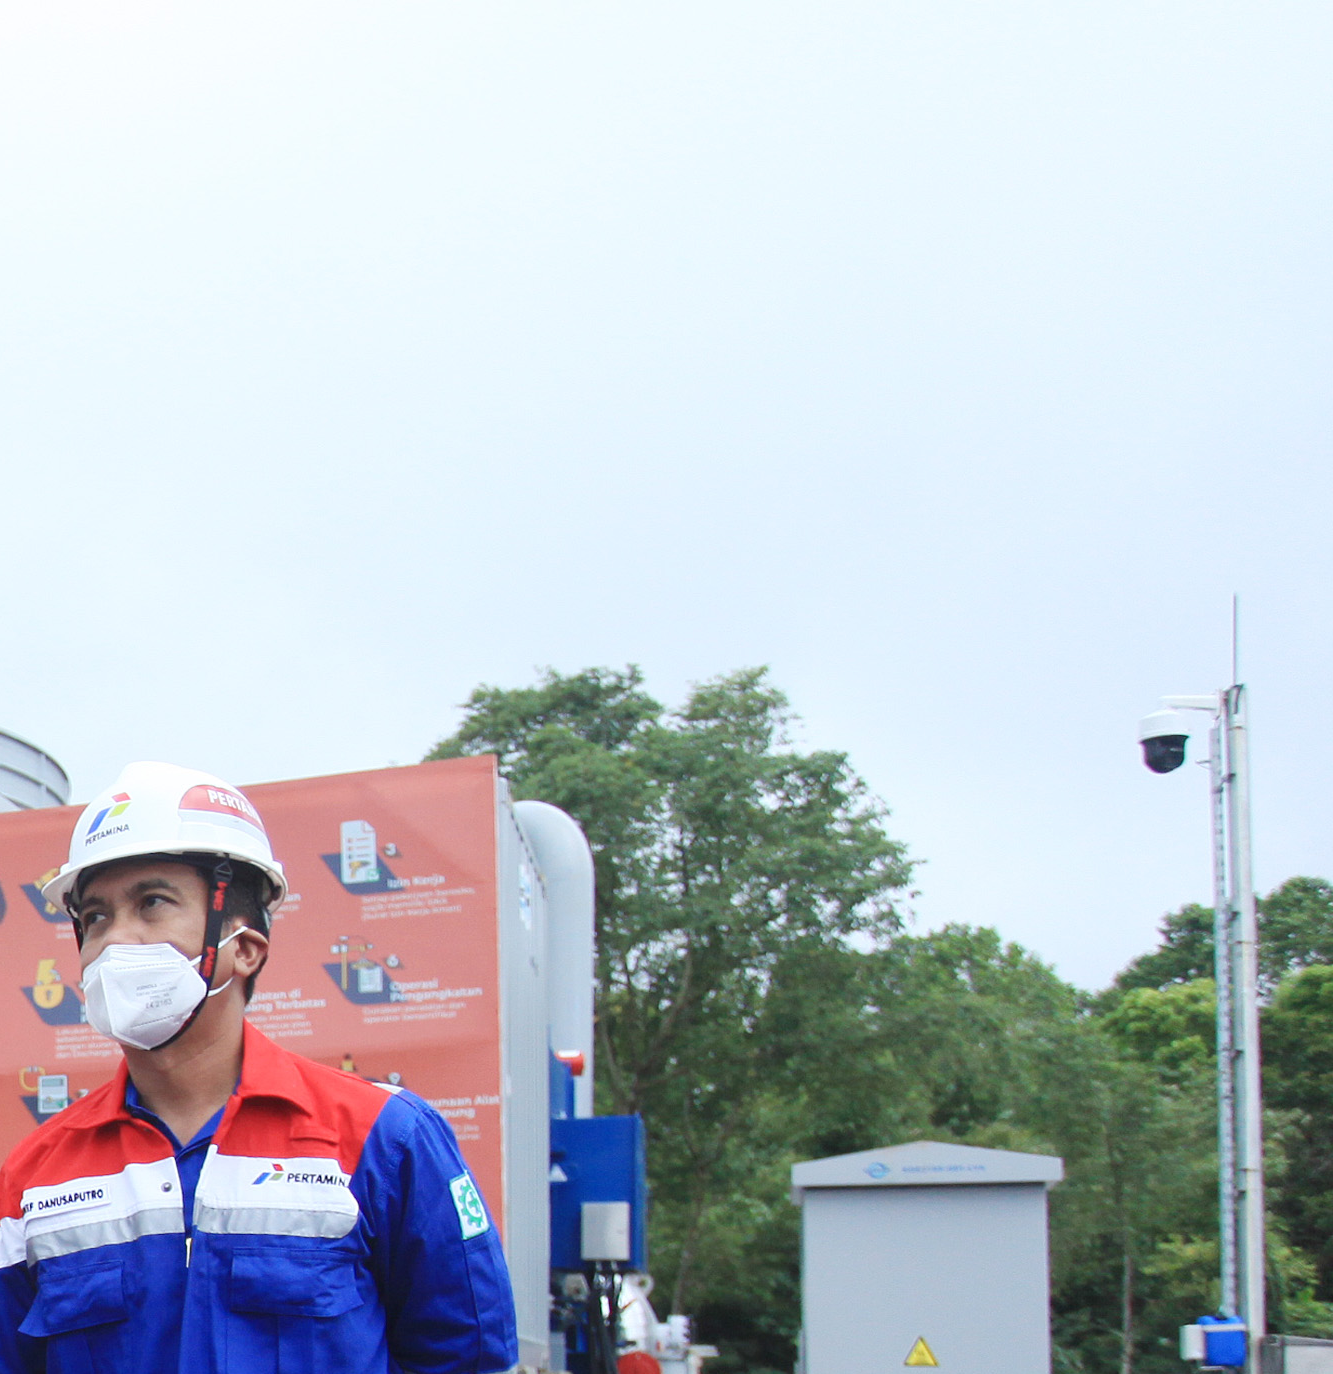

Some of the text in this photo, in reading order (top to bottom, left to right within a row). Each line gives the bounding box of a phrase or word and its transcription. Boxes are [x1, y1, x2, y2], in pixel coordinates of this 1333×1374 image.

[85, 823, 130, 847] PERTAMINA
[286, 1172, 346, 1188] PERTAMIN
[38, 1189, 104, 1211] DANUSAPUTRO
